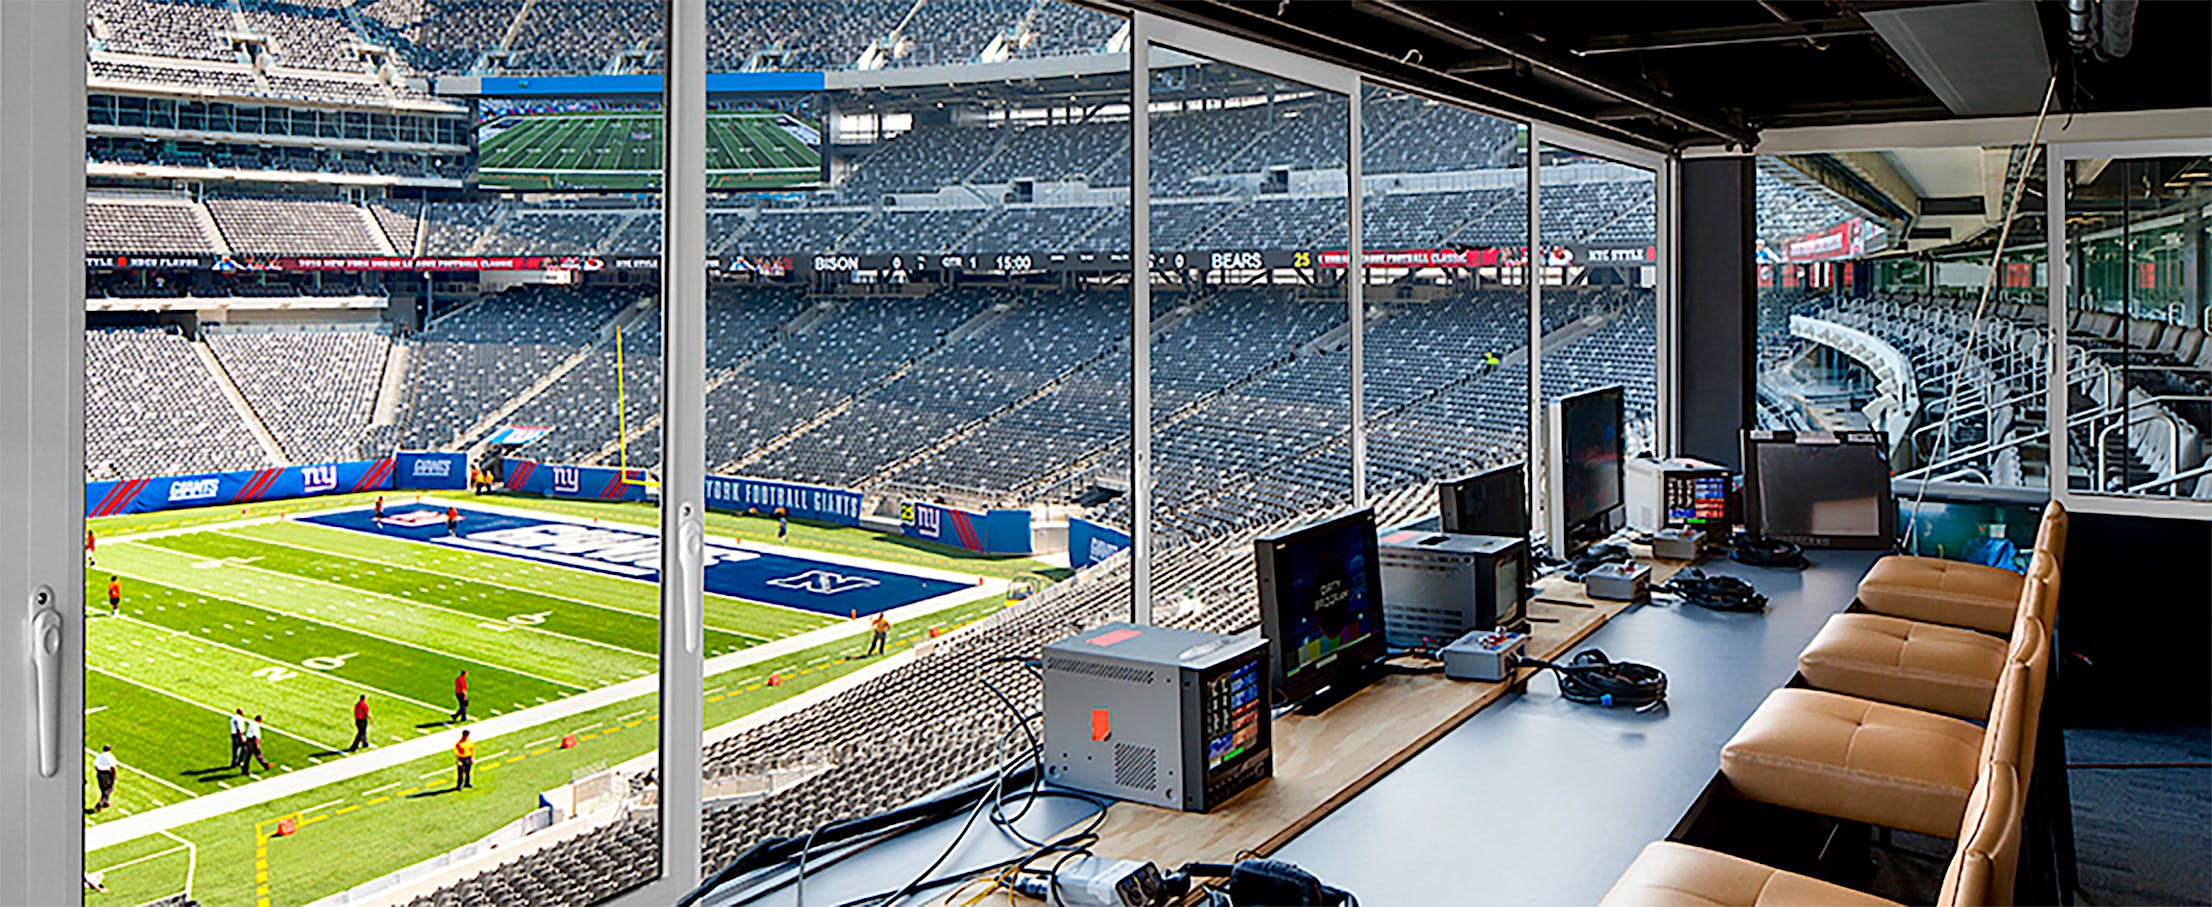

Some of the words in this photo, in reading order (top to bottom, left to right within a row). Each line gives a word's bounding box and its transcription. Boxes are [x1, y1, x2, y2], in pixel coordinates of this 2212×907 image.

[814, 256, 859, 271] BISON
[892, 256, 901, 269] 0
[968, 256, 977, 269] 1
[995, 256, 1033, 270] 15:00
[1174, 253, 1185, 268] 0
[1210, 252, 1263, 269] BEARS
[1293, 251, 1310, 268] 25
[167, 478, 220, 501] GIANTS
[705, 479, 740, 501] YORK
[745, 483, 808, 510] FOOTBALL
[814, 491, 859, 519] GIANTS
